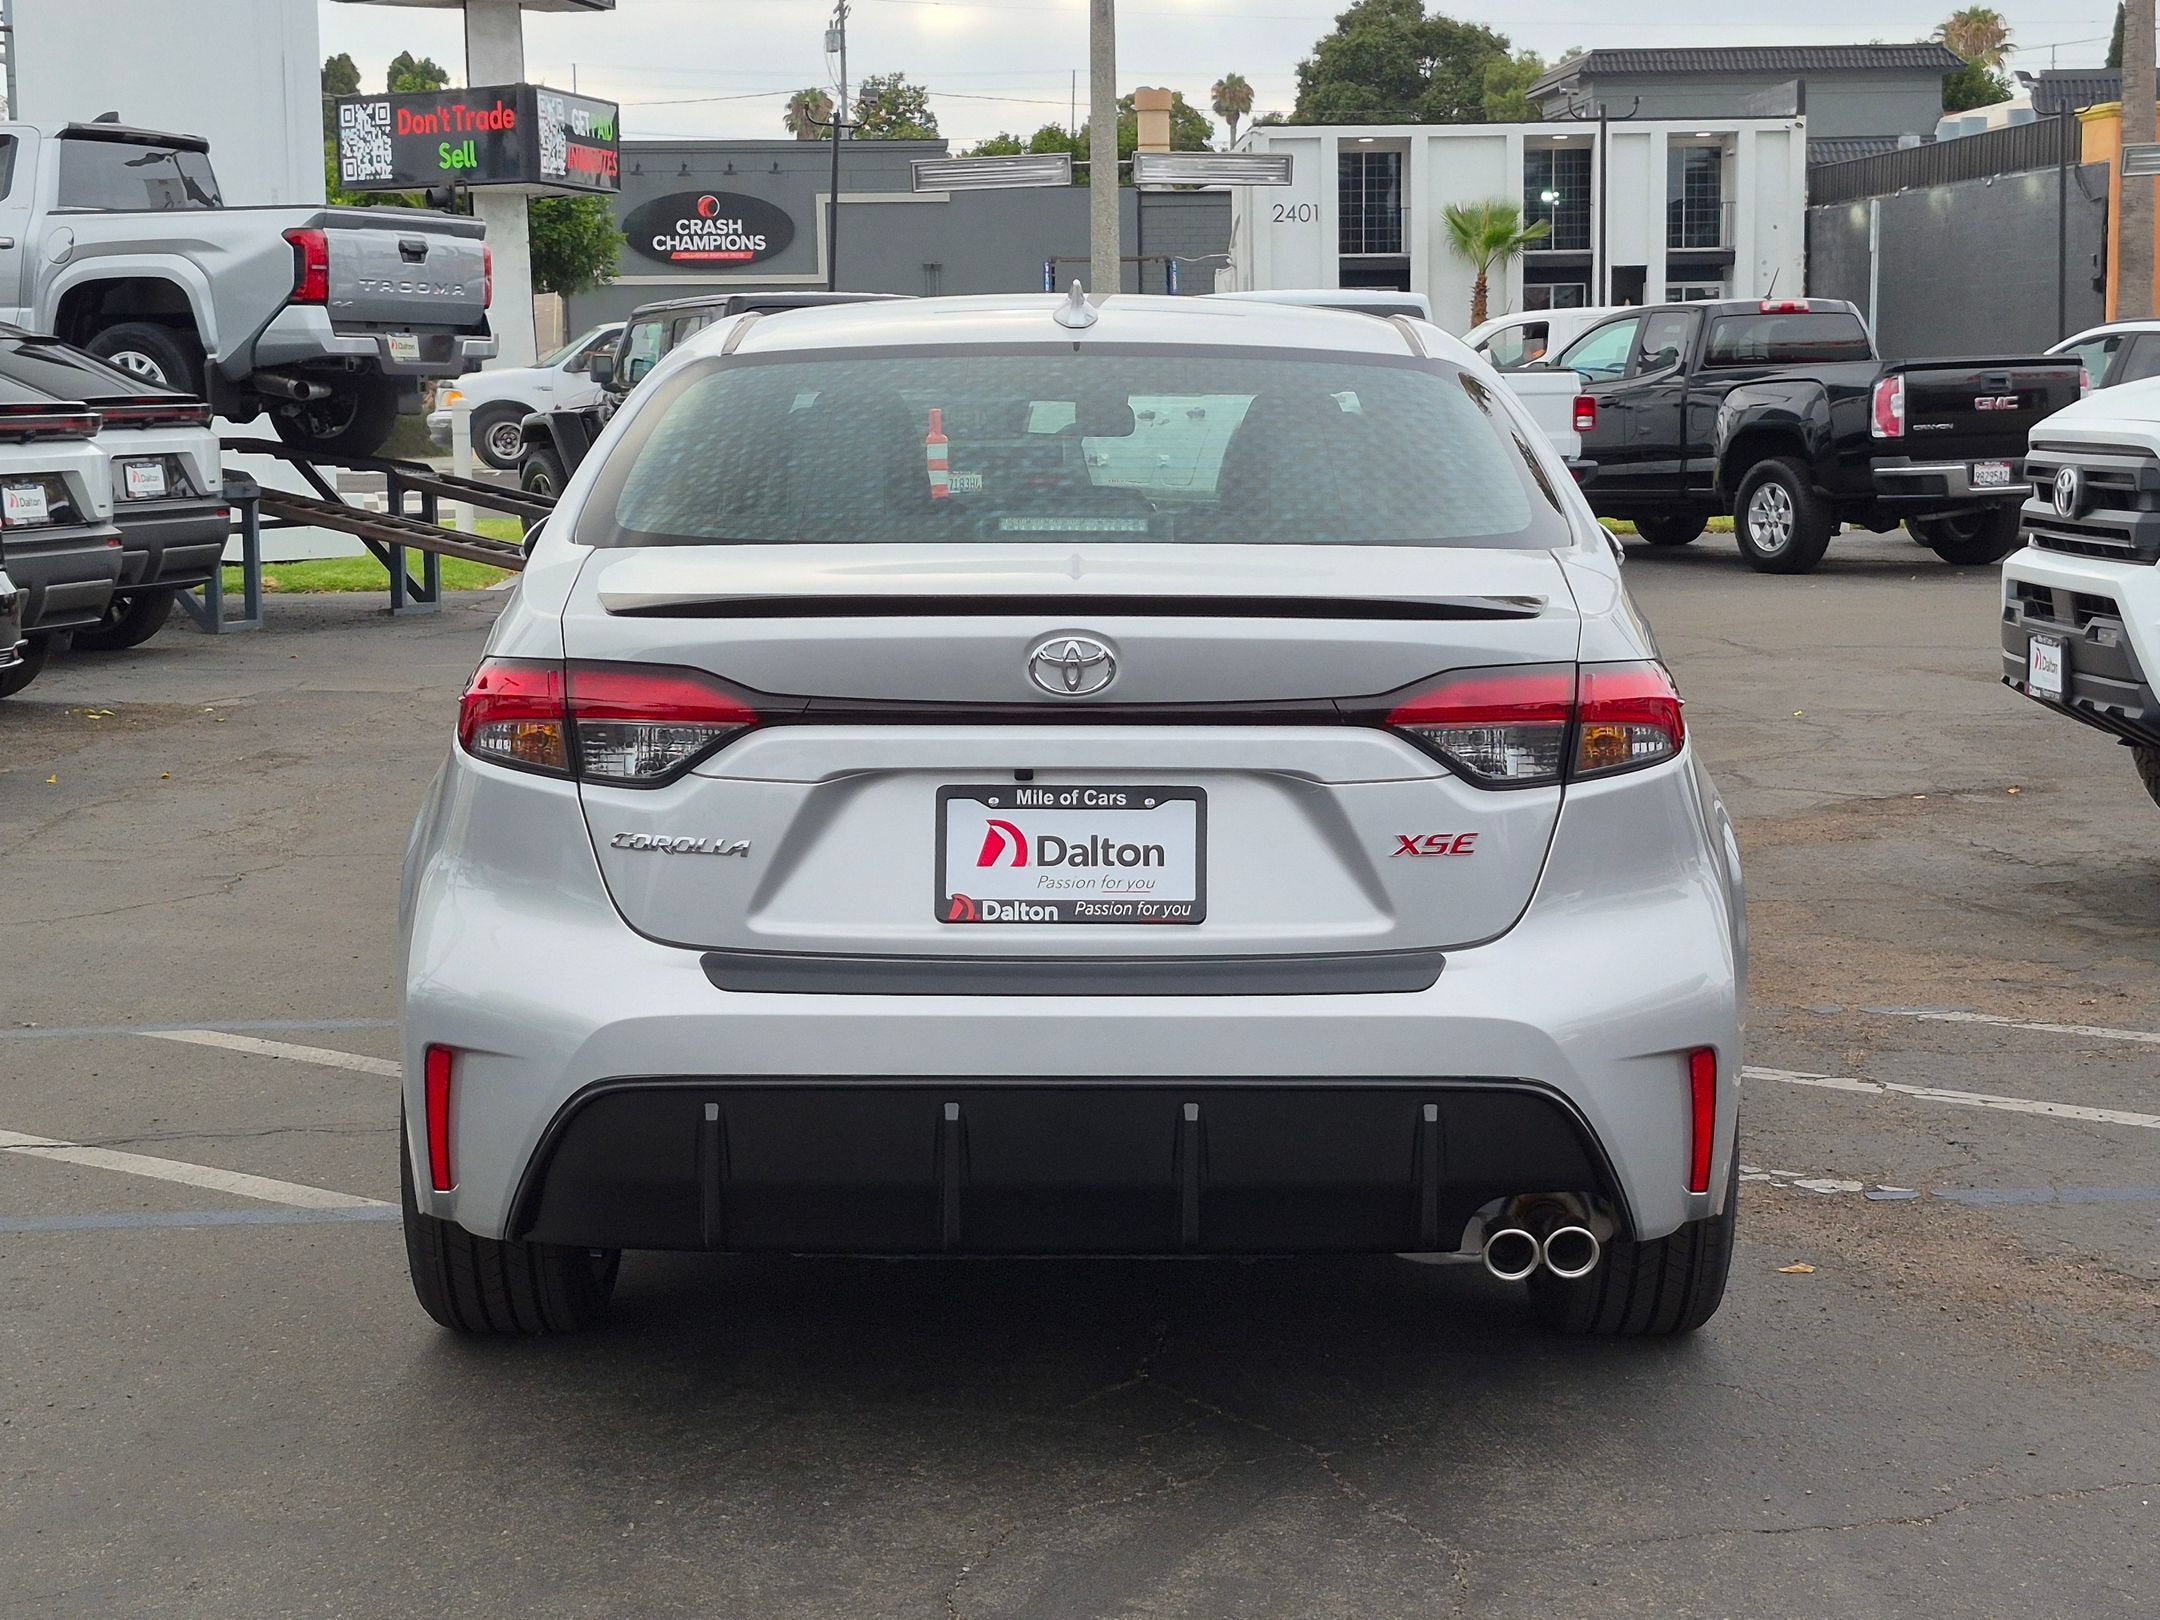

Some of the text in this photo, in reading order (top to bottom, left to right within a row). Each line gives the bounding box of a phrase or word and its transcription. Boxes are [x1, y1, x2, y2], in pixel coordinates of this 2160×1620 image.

[396, 100, 516, 135] Don't Trade
[439, 140, 478, 170] Sell
[1272, 203, 1318, 223] 2401
[675, 219, 742, 235] CRASH
[652, 235, 767, 251] CHAMPIONS
[359, 278, 465, 296] TACOMA
[1974, 395, 2019, 411] GMC
[1016, 789, 1127, 806] Mile of Cars
[610, 831, 751, 858] COROLLA
[1037, 834, 1165, 867] Dalton
[1390, 832, 1479, 857] XSE
[1037, 874, 1155, 893] Passion for you
[982, 900, 1191, 921] Dalton Passion for you
